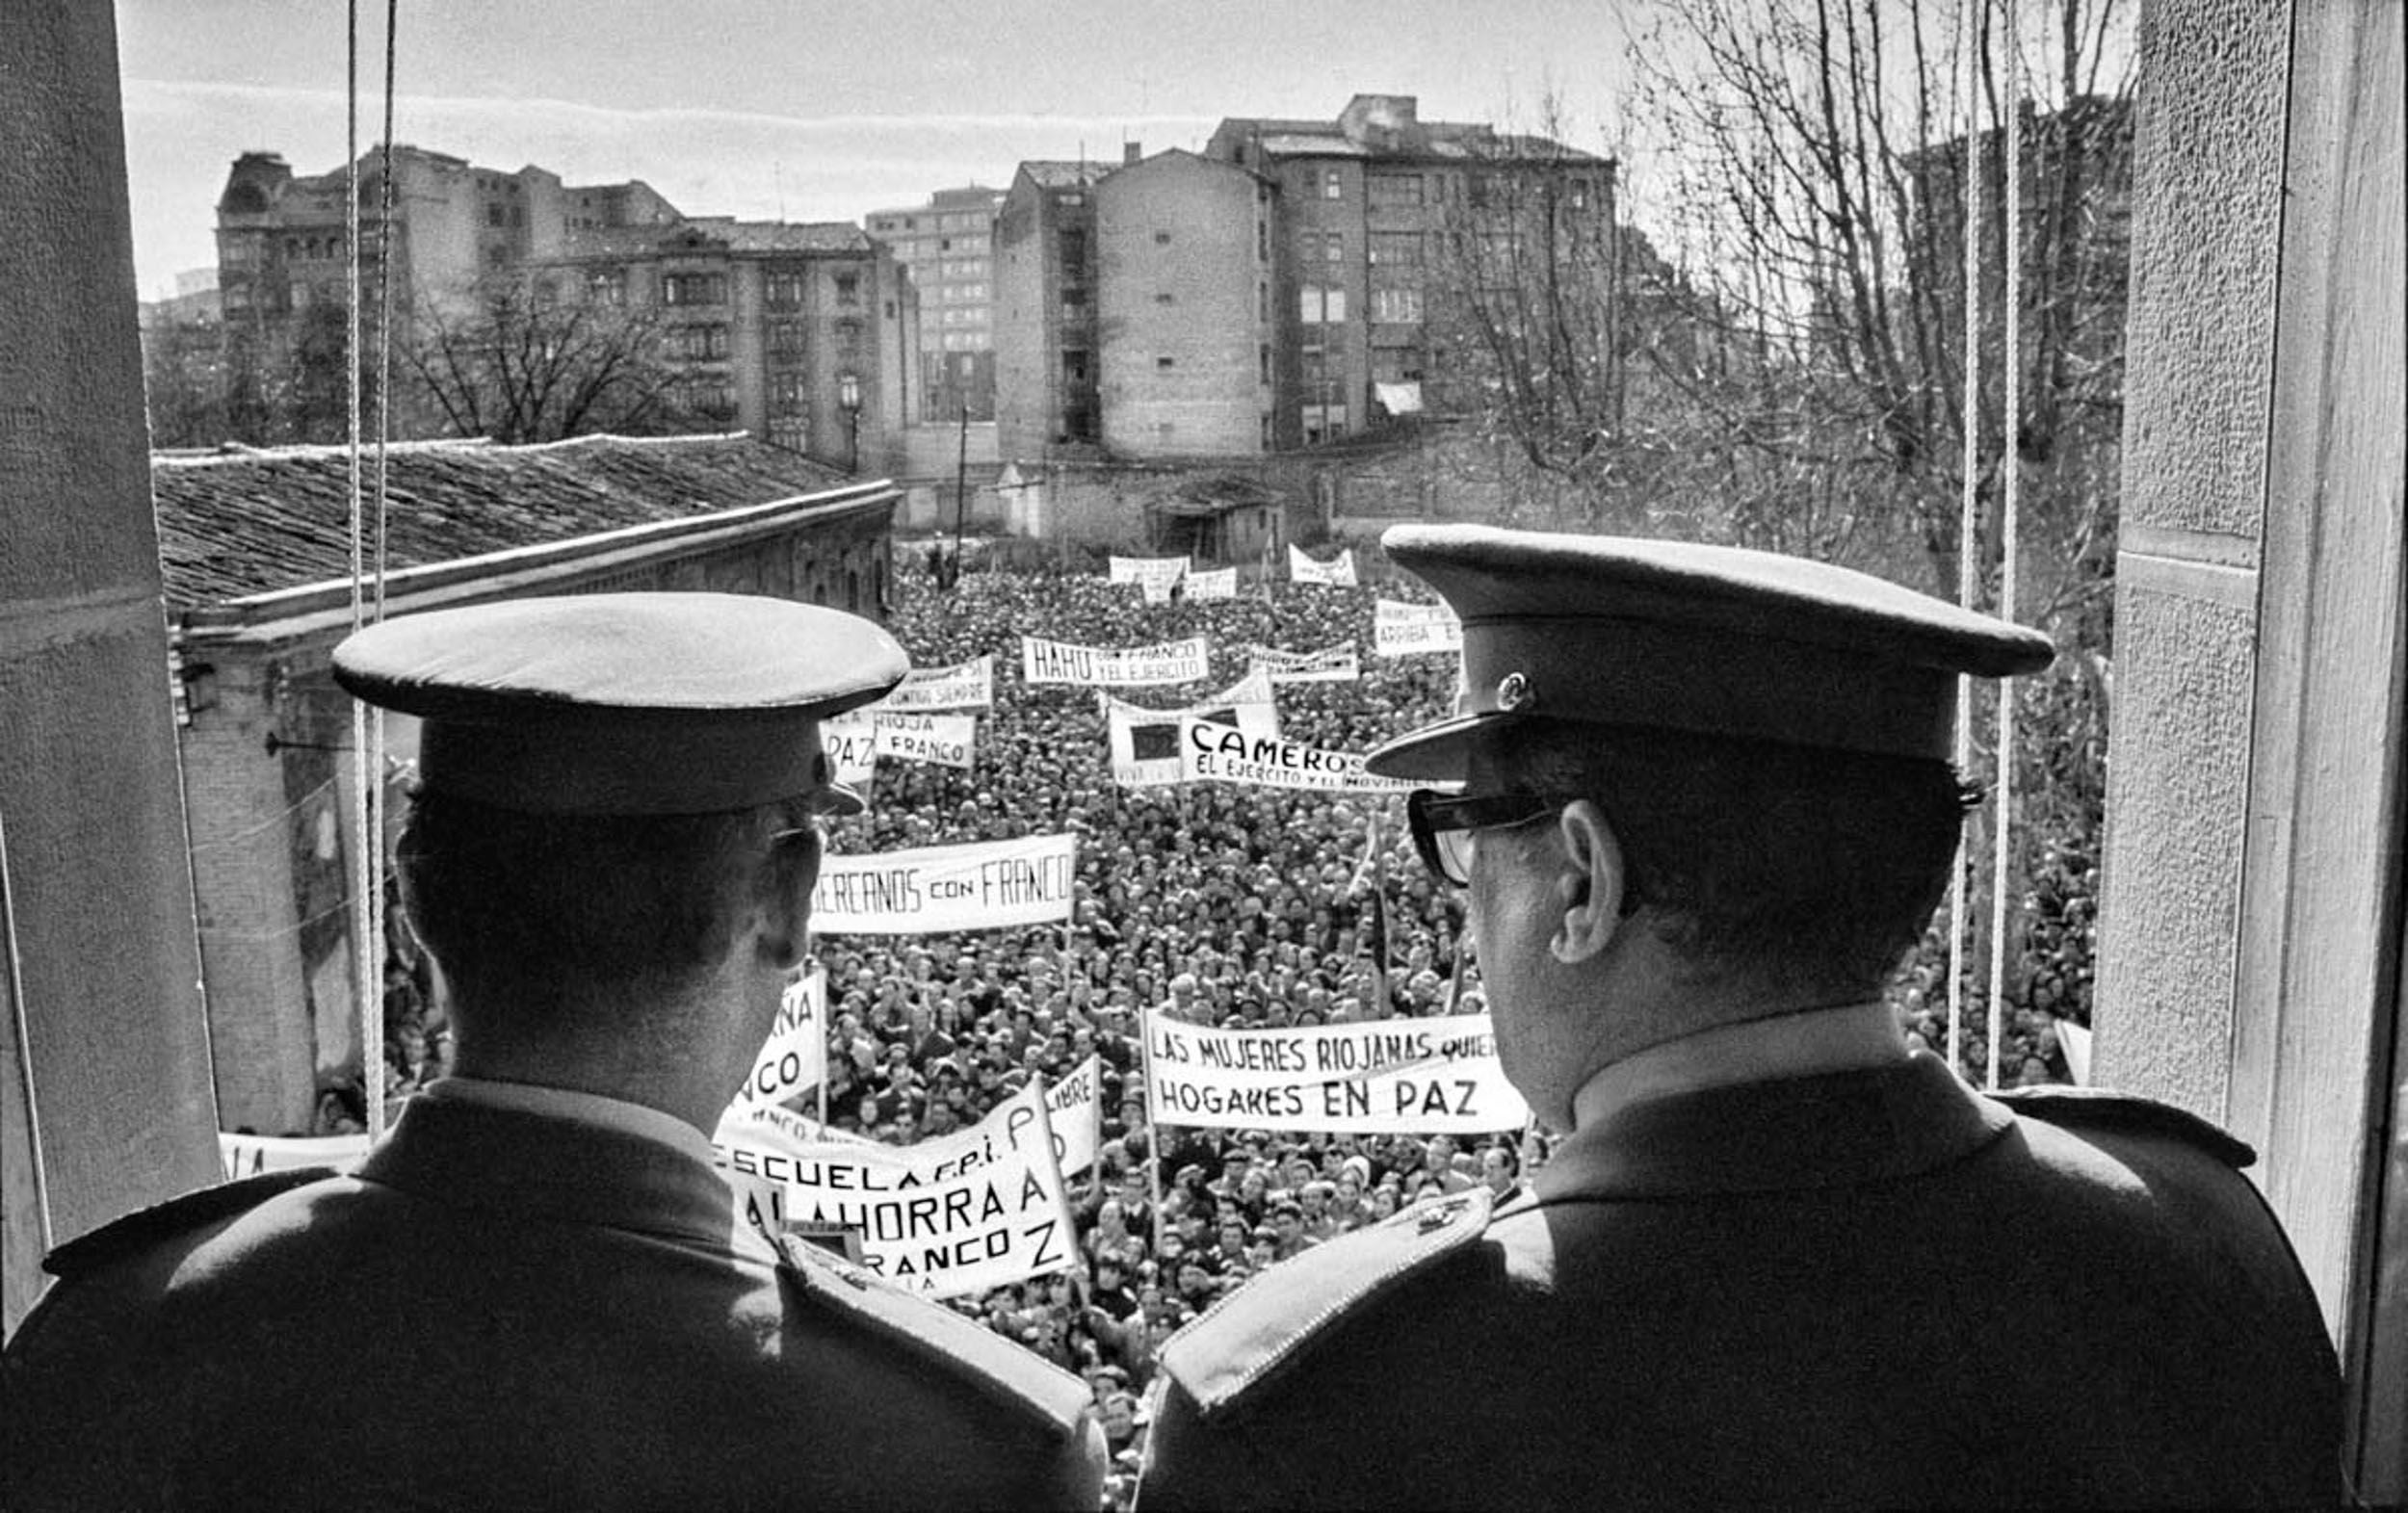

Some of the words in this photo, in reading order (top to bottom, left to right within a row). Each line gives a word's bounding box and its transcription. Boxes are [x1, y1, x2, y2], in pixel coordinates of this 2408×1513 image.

[890, 736, 964, 762] FRANCO
[1191, 723, 1365, 775] CAMEROS
[1197, 754, 1217, 774] EL
[1227, 759, 1301, 785] EJERCITO
[981, 853, 1069, 907] FRANCO
[1151, 1030, 1190, 1062] LAS
[1197, 1037, 1307, 1072] MUJERES
[1317, 1032, 1432, 1072] RIOJANAS
[1322, 1079, 1371, 1118] EN
[1396, 1080, 1479, 1117] PAZ
[711, 1142, 921, 1191] ESCUELA
